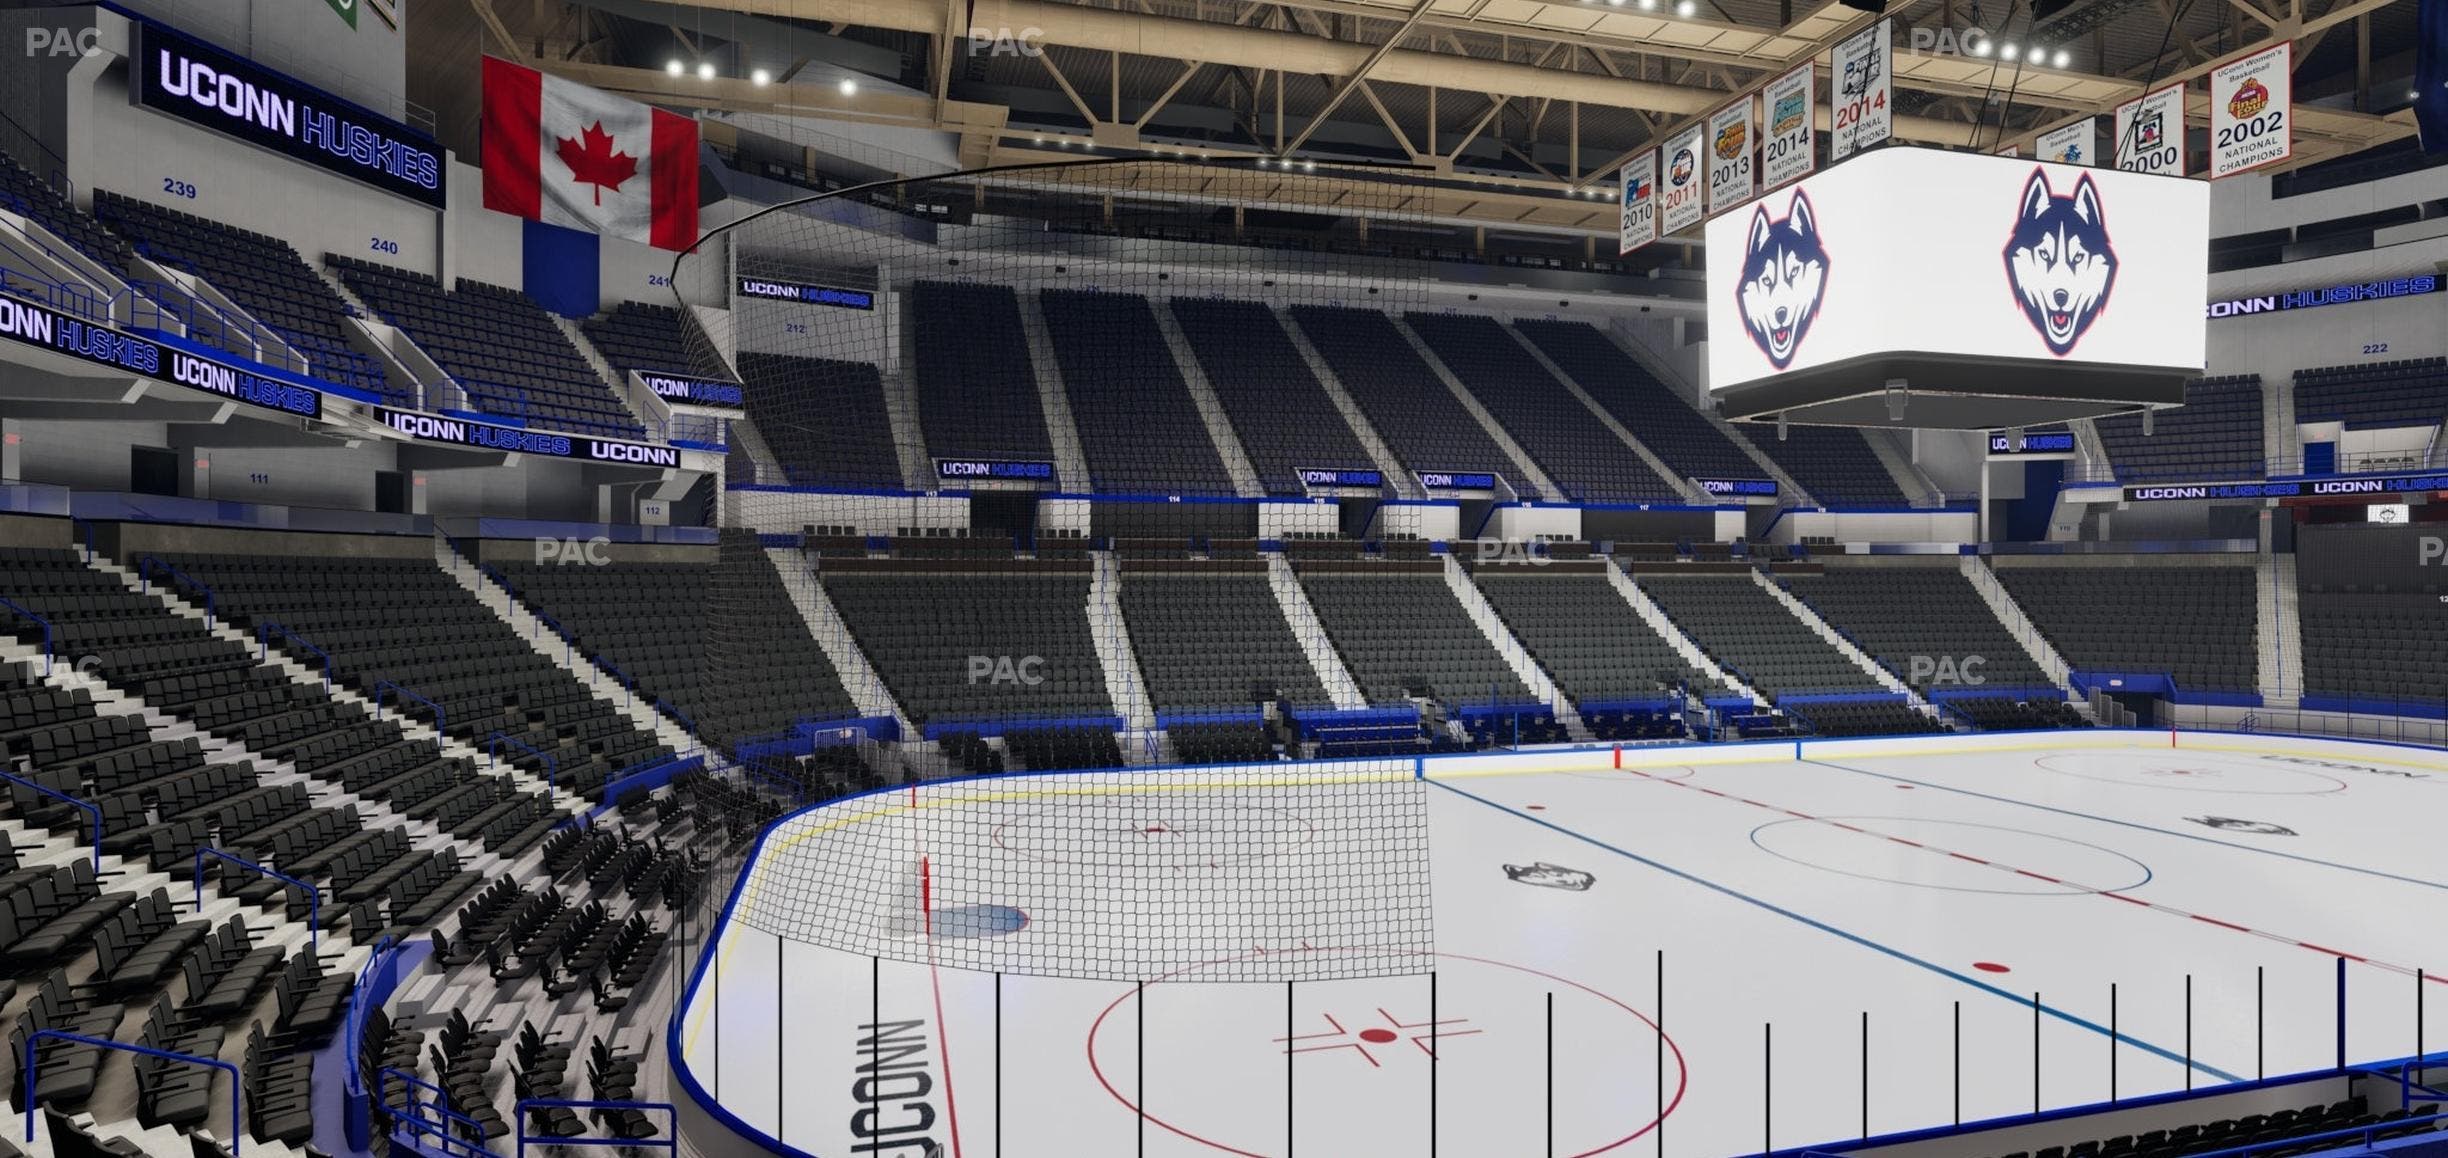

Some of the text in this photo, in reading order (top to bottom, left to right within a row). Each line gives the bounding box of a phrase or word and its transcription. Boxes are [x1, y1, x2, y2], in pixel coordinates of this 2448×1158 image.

[161, 49, 438, 190] UCONN HUSKIES
[1836, 88, 1886, 130] 2014
[2218, 111, 2283, 149] 2002
[1767, 126, 1809, 163] 2014
[2225, 137, 2278, 159] NATIONAL
[1772, 152, 1807, 172] NATIONAL
[2219, 147, 2284, 173] CHAMPIONS
[1712, 156, 1749, 188] 2013
[1768, 161, 1810, 186] CHAMPIONS
[163, 178, 197, 200] 239
[1666, 181, 1697, 210] 2011
[1713, 189, 1749, 210] CHAMPIONS
[1717, 182, 1747, 197] NATIONAL
[1623, 203, 1653, 230] 2010
[371, 237, 399, 255] 240
[648, 275, 671, 287] 241
[744, 279, 799, 298] UCONN
[2282, 275, 2436, 310] HUSKIES
[785, 323, 806, 334] 212
[57, 317, 159, 374] HUSKIES
[2362, 343, 2388, 354] 222
[173, 353, 316, 415] UCONN HUSKIES
[469, 425, 571, 456] HUSKIES
[591, 441, 676, 465] UCONN
[251, 473, 269, 485] 111
[943, 462, 990, 475] UCONN
[1303, 471, 1337, 483] UCONN
[2136, 487, 2206, 500] UCONN
[2314, 480, 2383, 494] UCONN
[645, 506, 661, 516] 112
